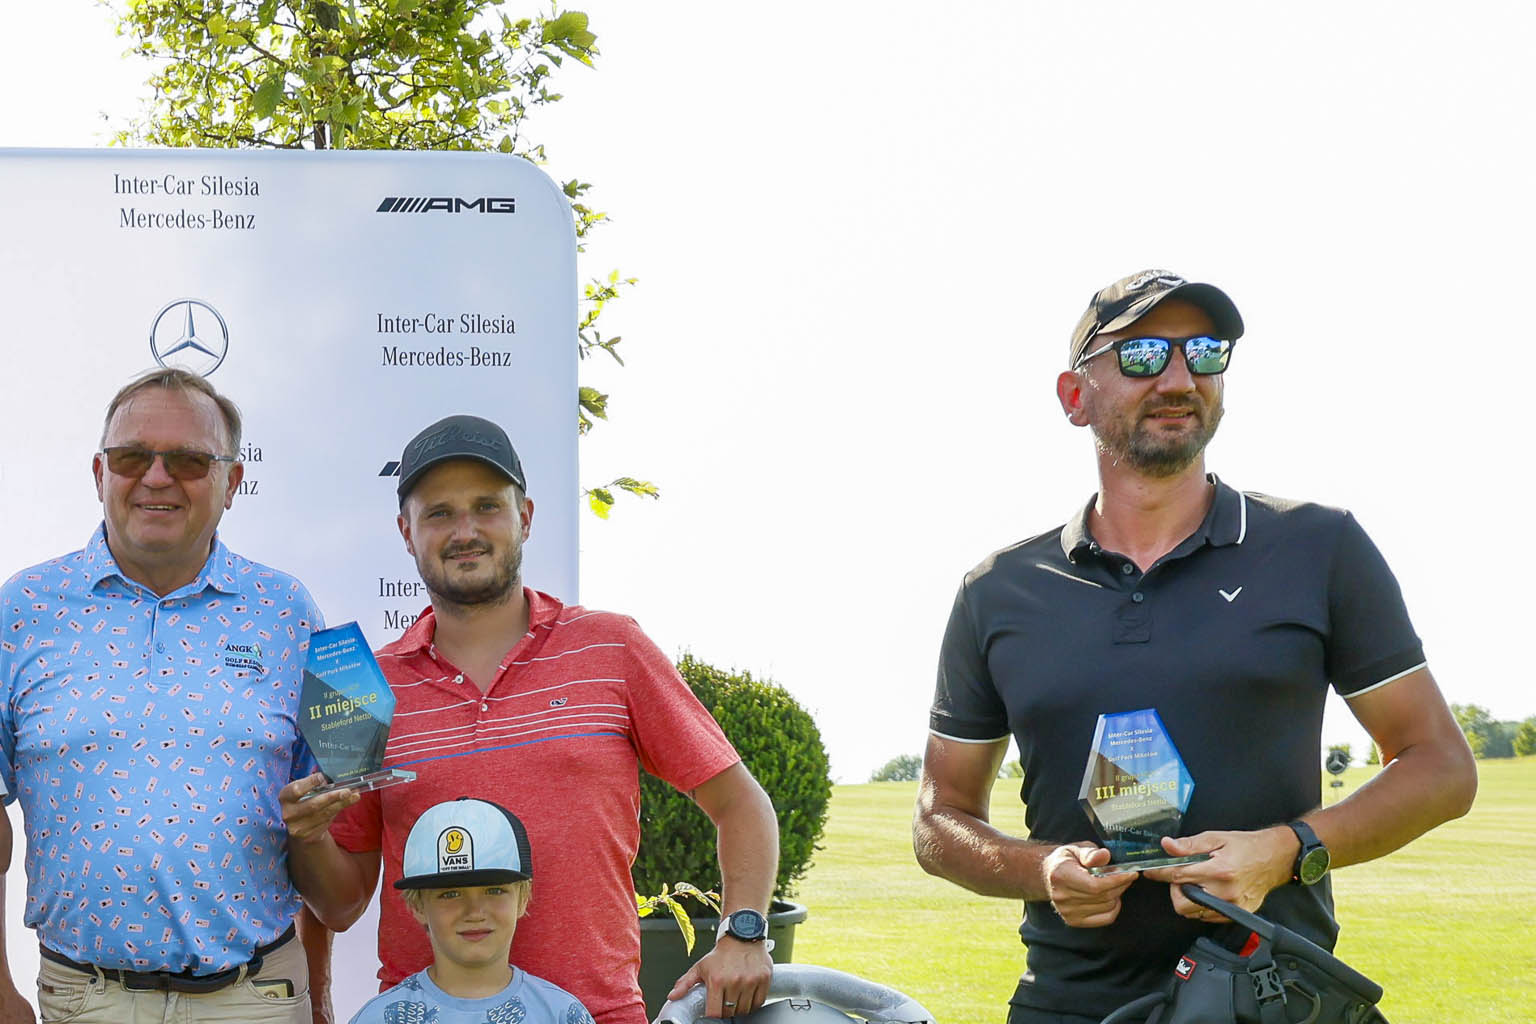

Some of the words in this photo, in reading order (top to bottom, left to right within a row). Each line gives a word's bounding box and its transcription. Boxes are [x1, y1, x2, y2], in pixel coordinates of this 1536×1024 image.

[114, 174, 195, 195] Inter-Car
[201, 175, 260, 196] Silesia
[421, 197, 516, 214] AMG
[120, 208, 256, 229] Mercedes-Benz
[377, 313, 455, 334] Inter-Car
[460, 313, 516, 335] Silesia
[382, 346, 512, 367] Mercedes-Benz
[378, 577, 428, 598] Inter-
[309, 704, 322, 720] II
[325, 691, 377, 717] miejsce
[321, 717, 353, 732] Stableford
[354, 712, 372, 724] Netto
[1095, 785, 1116, 800] III
[1119, 780, 1177, 798] miejsce
[443, 854, 468, 866] VANS
